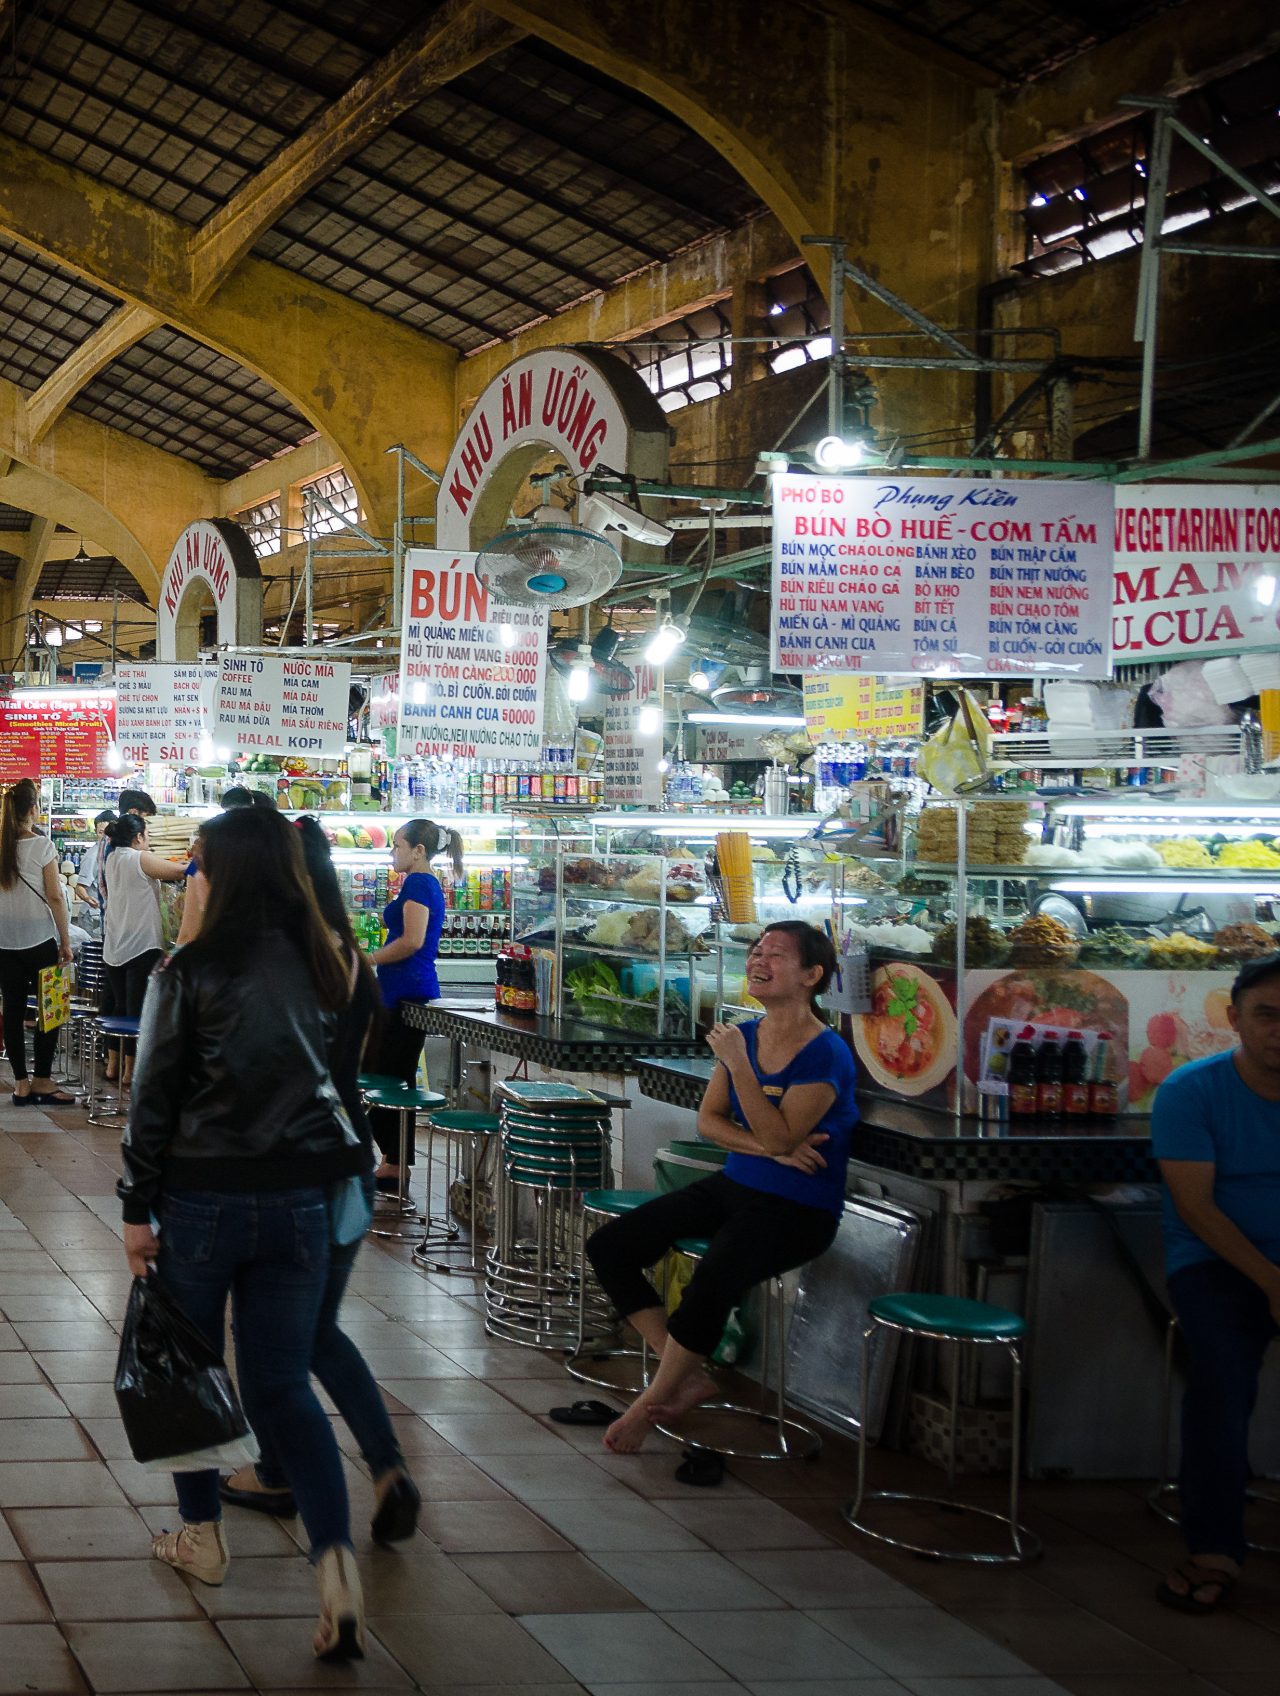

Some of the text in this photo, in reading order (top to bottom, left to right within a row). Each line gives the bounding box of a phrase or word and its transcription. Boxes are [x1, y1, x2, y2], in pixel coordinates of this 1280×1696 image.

[449, 365, 607, 516] KHU ĂN UỐNG
[874, 485, 955, 511] Phụng
[795, 509, 846, 538] BÚN
[856, 511, 892, 538] BÒ
[1040, 515, 1097, 544] TẤM
[1115, 507, 1238, 553] VEGETARIAN
[782, 540, 837, 557] BÚN MỌC
[916, 543, 976, 561] BÁNH XÈO
[990, 544, 1014, 562] BÚN
[165, 529, 229, 618] KHU ĂN UỐNG
[781, 560, 805, 575] BÚN
[915, 563, 975, 580] BÁNH BÈO
[990, 564, 1014, 581] BÚN
[1017, 567, 1040, 584] THỊT
[410, 559, 490, 623] BÚN
[781, 578, 834, 594] BÚN RIÊU
[915, 584, 960, 598] BÒ KHO
[990, 583, 1013, 599] BÚN
[1017, 586, 1043, 600] NEM
[800, 596, 817, 611] TÍU
[821, 600, 848, 613] NAM
[852, 600, 884, 614] VANG
[915, 601, 931, 614] BÍT
[990, 601, 1079, 620] BÚN CHẠO TÔM
[514, 612, 529, 625] CUA
[779, 613, 901, 633] MIẾN GÀ MÌ QUẢNG
[913, 618, 957, 633] BÚN CÁ
[989, 618, 1078, 635] BÚN TÔM CÀNG
[409, 621, 484, 642] MÌ QUẢNG MIẾN
[779, 633, 876, 650] BÁNH CANH CUA
[913, 637, 939, 651] TÔM
[989, 638, 1000, 653] BÌ
[1069, 637, 1102, 655] CUỐN
[426, 642, 444, 659] TÍU
[447, 646, 470, 660] NAM
[474, 648, 501, 663] VANG
[505, 651, 538, 666] 50000
[223, 658, 264, 673] SINH TỐ
[283, 661, 334, 677] NƯỚC MÍA
[407, 661, 430, 677] BÚN
[435, 663, 459, 678] TÔM
[462, 664, 492, 681] CÀNG
[222, 673, 253, 683] COFFEE
[284, 676, 320, 688] MÍA CAM
[221, 687, 237, 696] RAU
[283, 690, 298, 701] MÍA
[221, 700, 236, 709] RAU
[282, 703, 324, 716] MÍA THƠM
[41, 711, 62, 720] TỐ
[220, 714, 235, 723] RAU
[281, 717, 296, 728] MÍA
[440, 705, 472, 719] CANH
[476, 708, 499, 721] CUA
[502, 709, 535, 724] 50000
[237, 733, 323, 749] HALAL KOPI
[415, 742, 448, 757] CANH
[122, 742, 149, 760] CHÈ
[160, 742, 184, 760] SÀI
